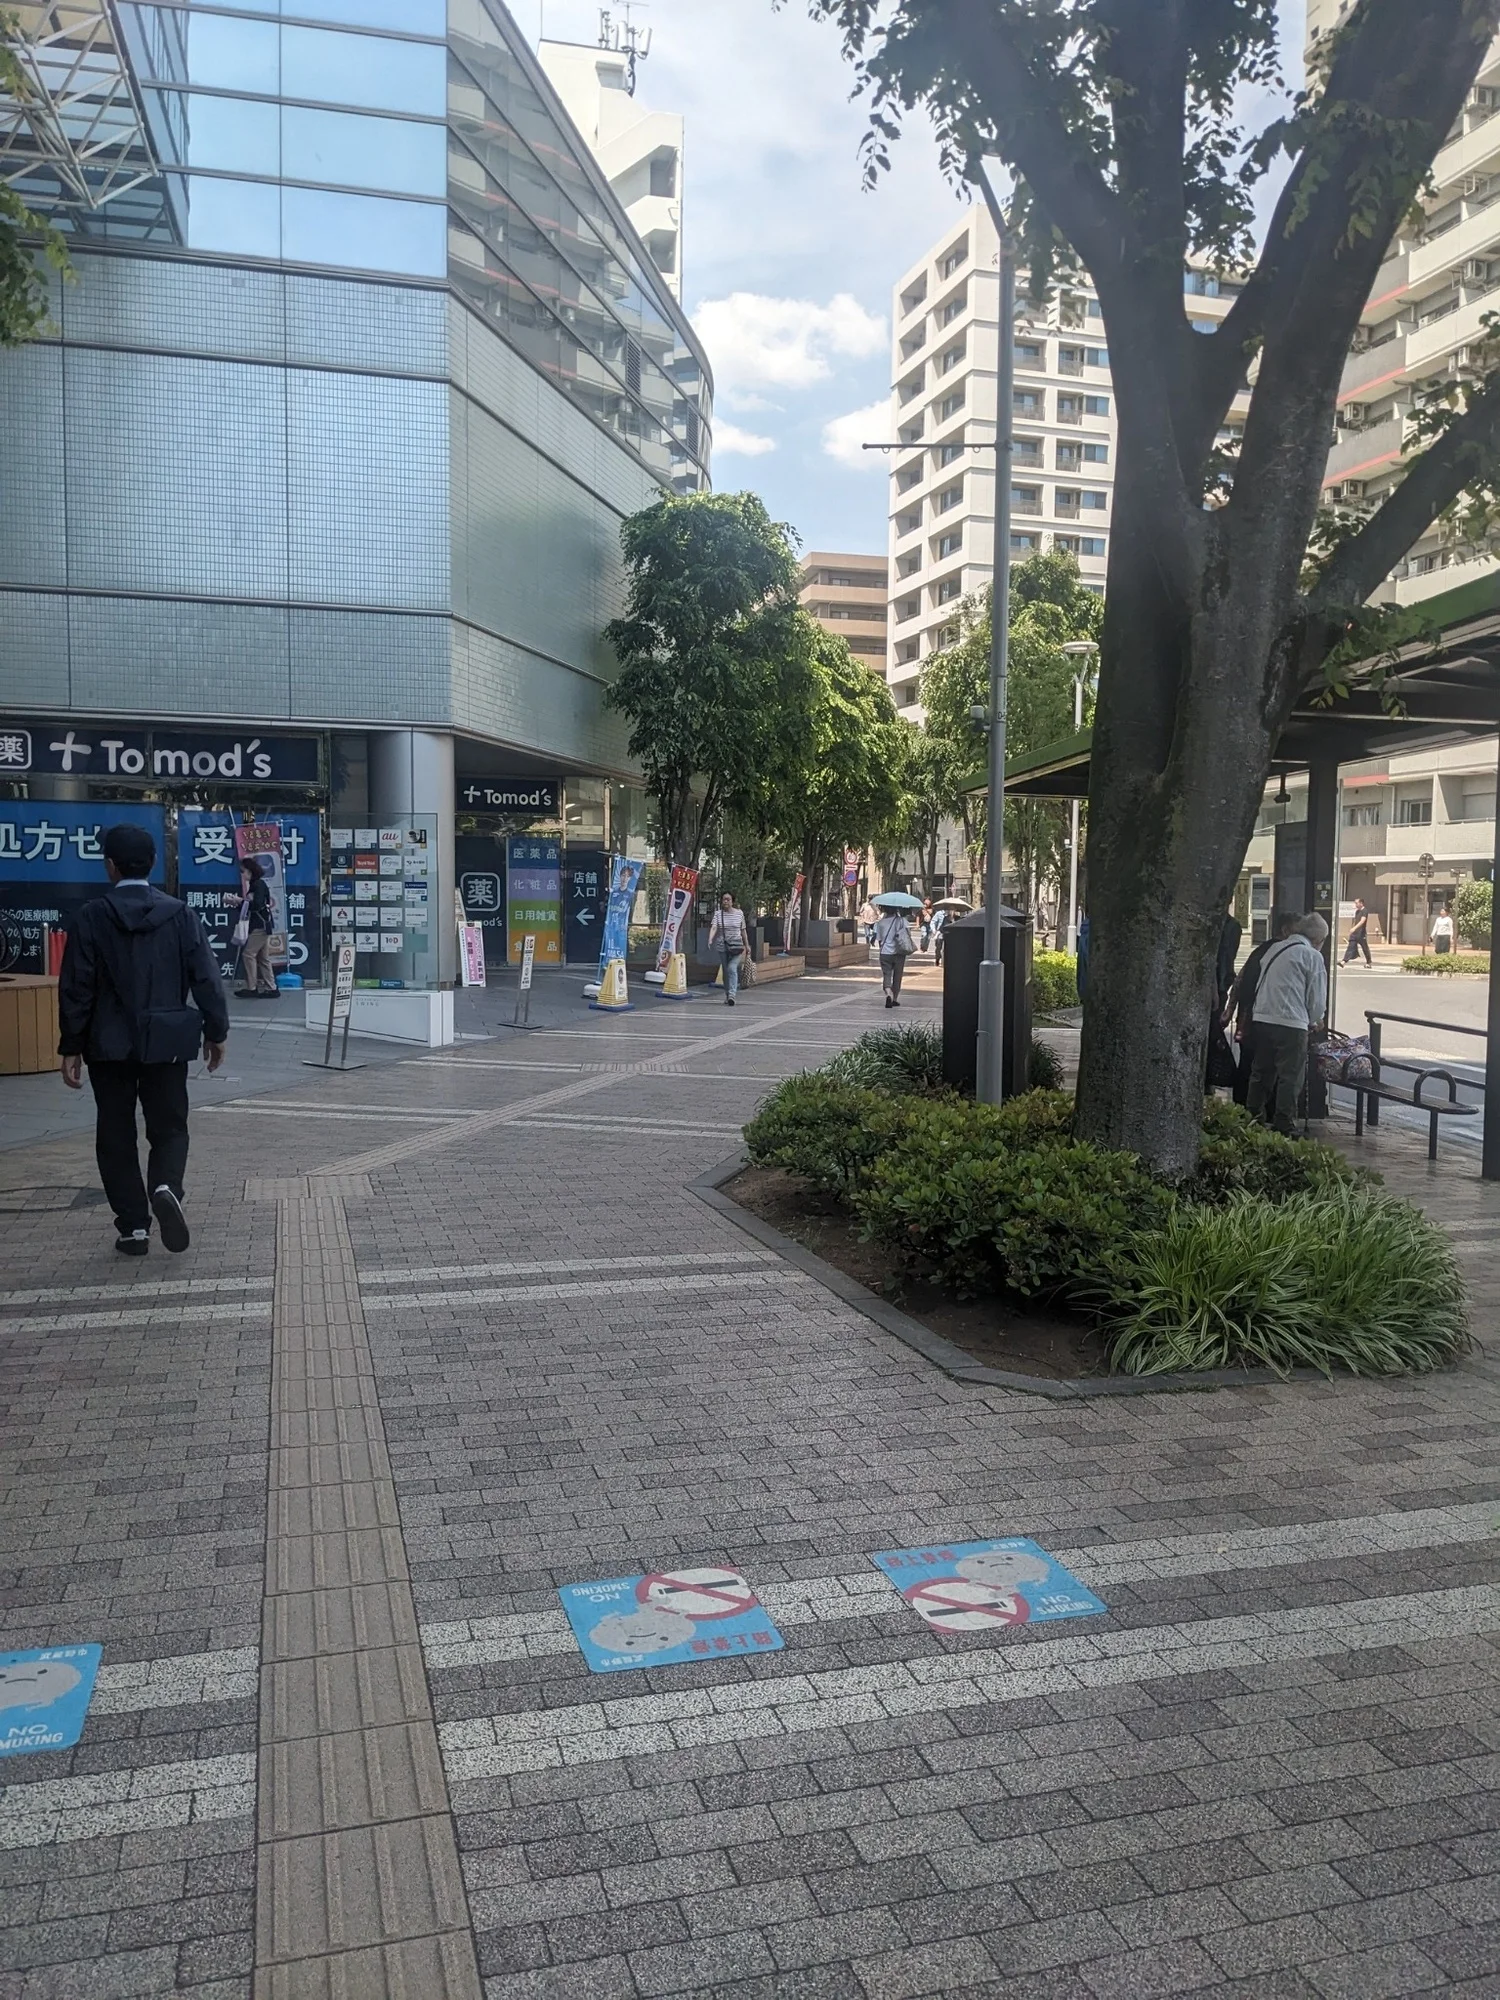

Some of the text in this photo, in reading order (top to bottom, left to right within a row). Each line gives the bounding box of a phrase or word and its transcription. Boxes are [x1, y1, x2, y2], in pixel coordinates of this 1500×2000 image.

[0, 736, 24, 763] 薬
[100, 738, 272, 778] Tomod's
[483, 788, 552, 806] Tomod's
[513, 847, 558, 860] 医薬品
[513, 878, 558, 890] 化粧品
[573, 871, 598, 884] 店舗
[467, 878, 494, 905] 薬
[573, 886, 598, 898] 入口
[514, 909, 558, 922] 日用雑貨
[571, 1581, 630, 1597] SMOKING
[590, 1593, 620, 1603] NO
[1040, 1594, 1072, 1604] NO
[1035, 1600, 1096, 1616] SMOKING
[7, 1723, 49, 1738] NO
[0, 1732, 64, 1750] MOKING
